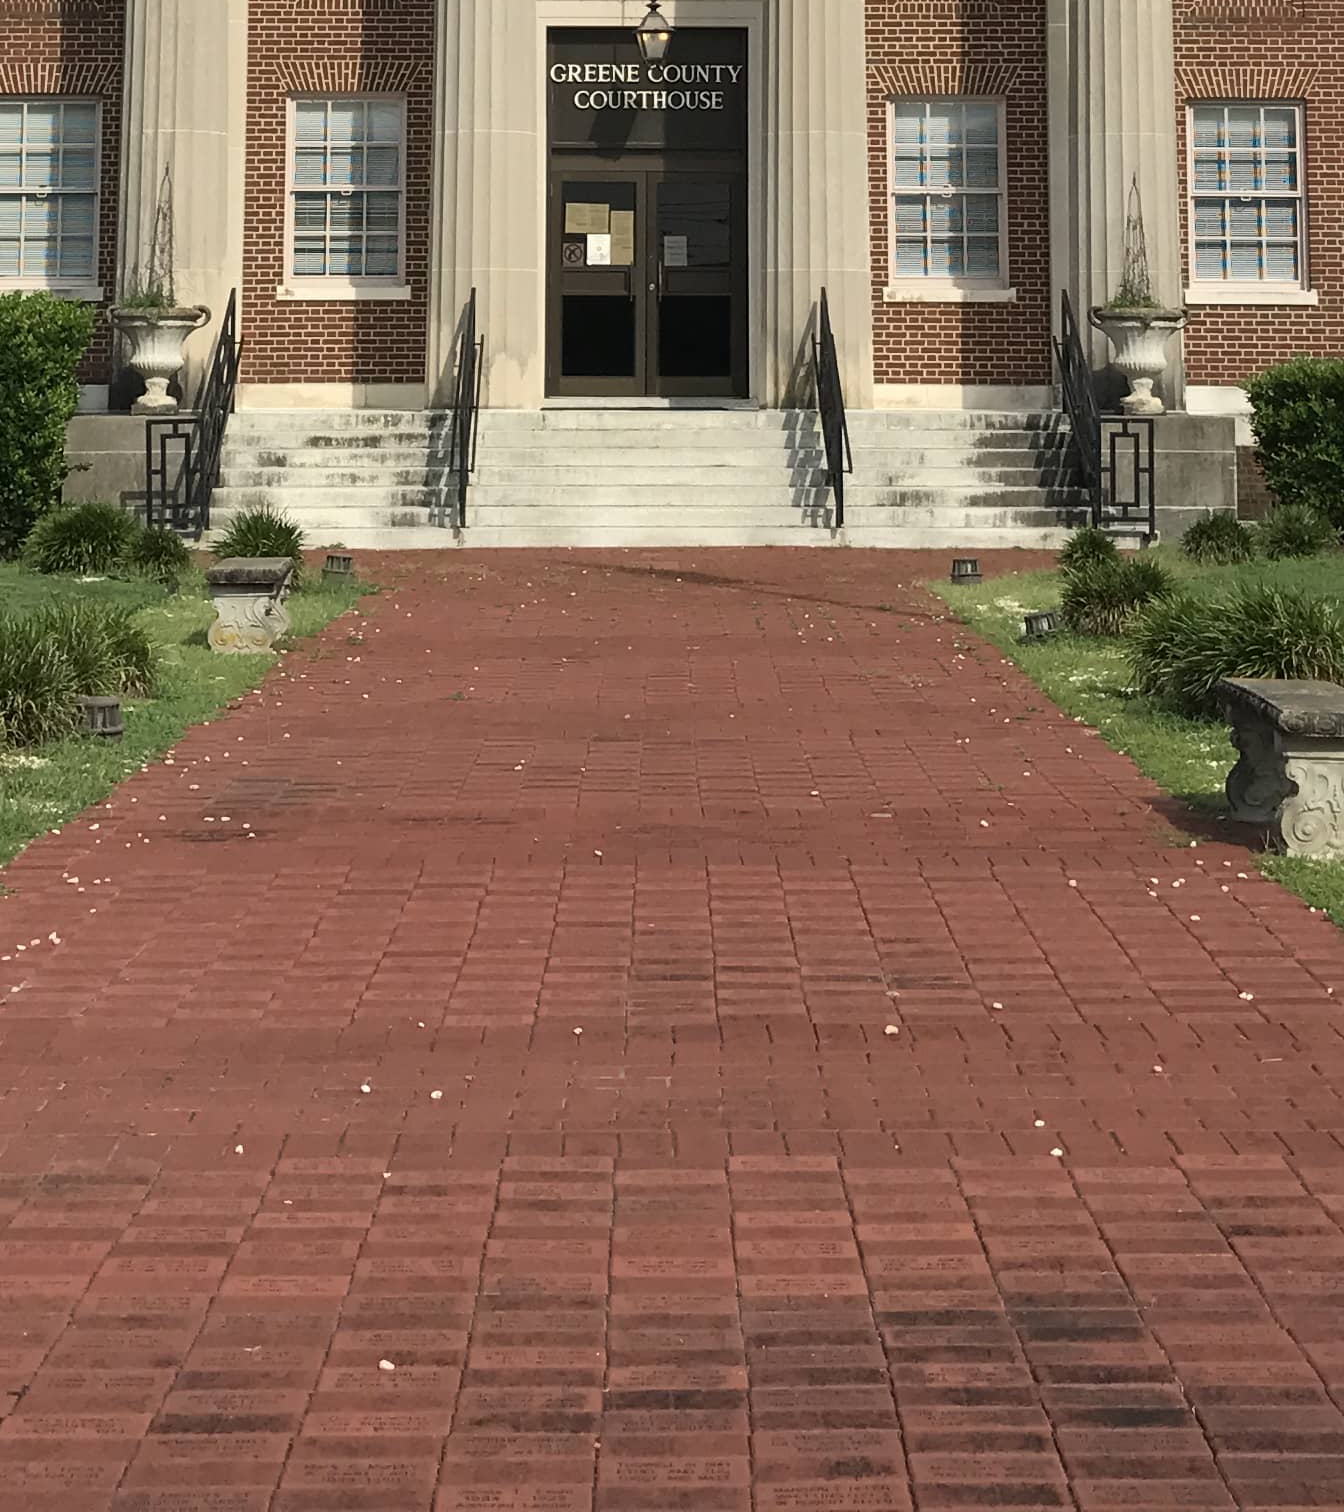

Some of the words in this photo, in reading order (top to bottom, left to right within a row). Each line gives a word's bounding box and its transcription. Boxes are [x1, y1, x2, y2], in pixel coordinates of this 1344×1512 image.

[549, 63, 640, 83] GREENE
[647, 64, 743, 84] COUNTY
[573, 90, 724, 110] COURTHOUSE
